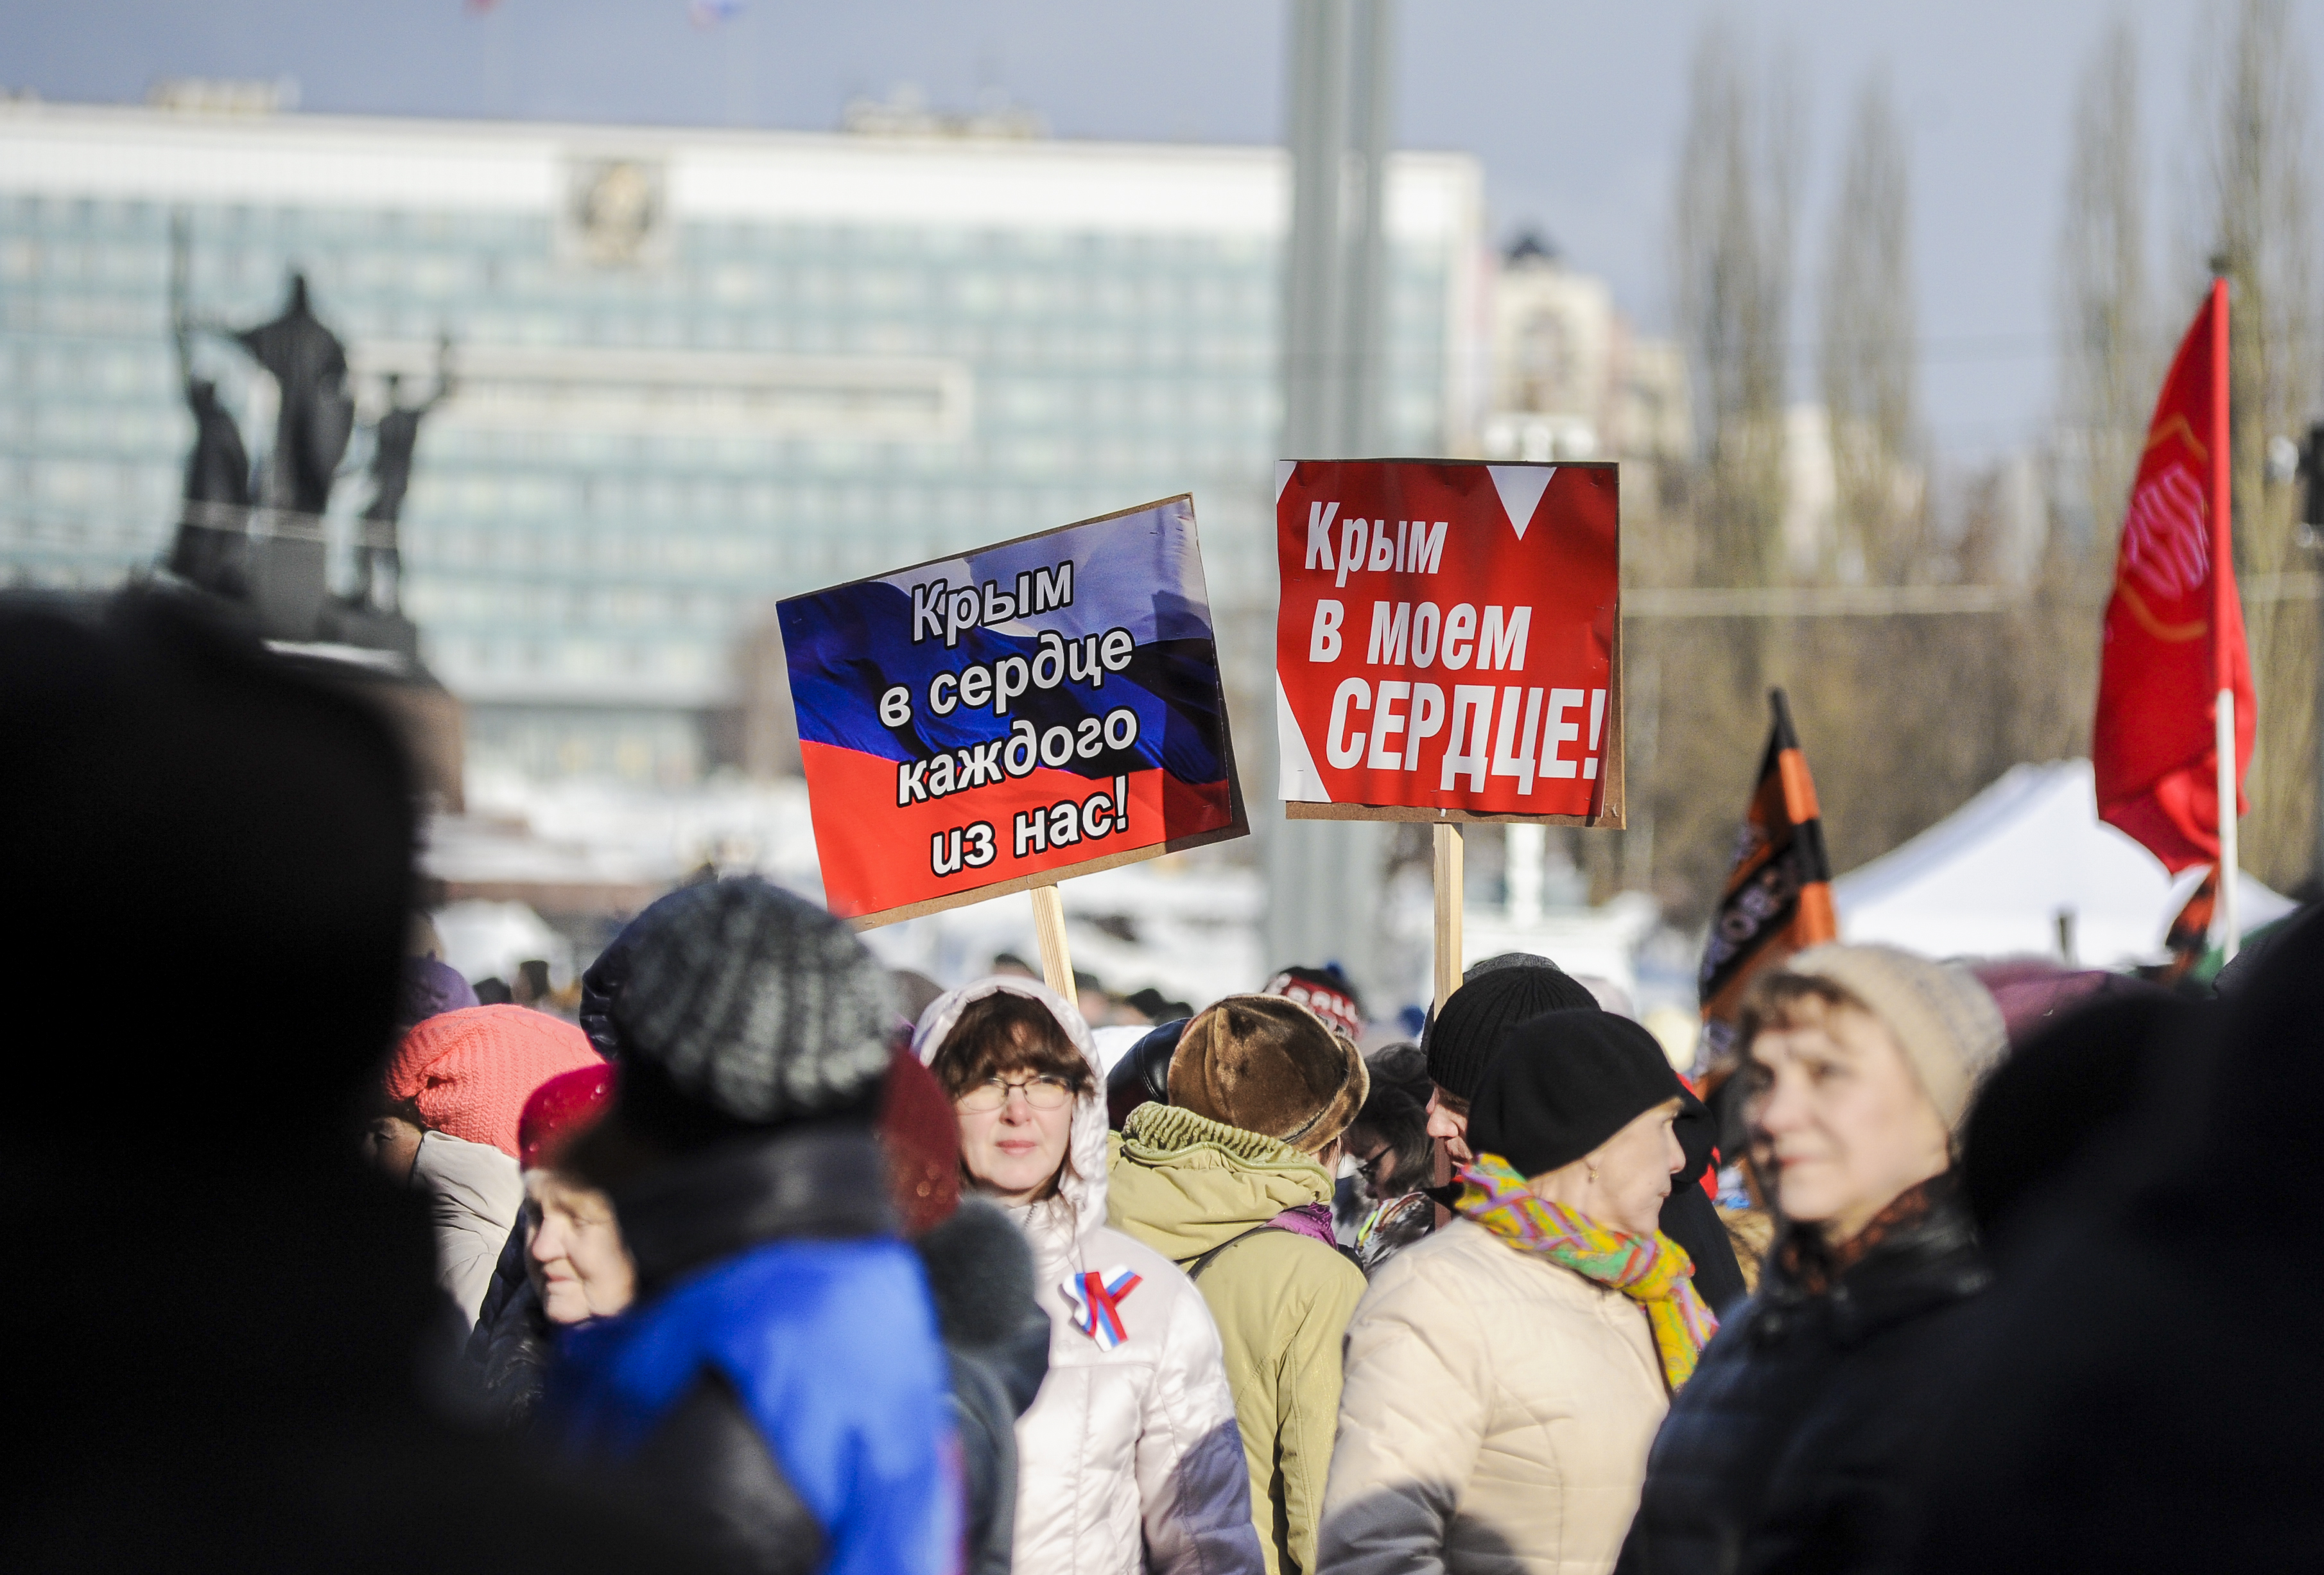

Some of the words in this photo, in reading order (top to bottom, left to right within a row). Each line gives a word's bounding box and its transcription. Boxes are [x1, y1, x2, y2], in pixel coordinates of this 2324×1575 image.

[1305, 501, 1448, 587] Крым
[912, 561, 1073, 646] Крым
[1367, 601, 1532, 671] моем
[879, 686, 912, 728] в
[929, 629, 1134, 715] сердце
[898, 708, 1138, 806] каждого
[1326, 677, 1606, 795] СЕРДЦЕ!
[931, 822, 996, 875] из
[1014, 775, 1127, 856] нас!
